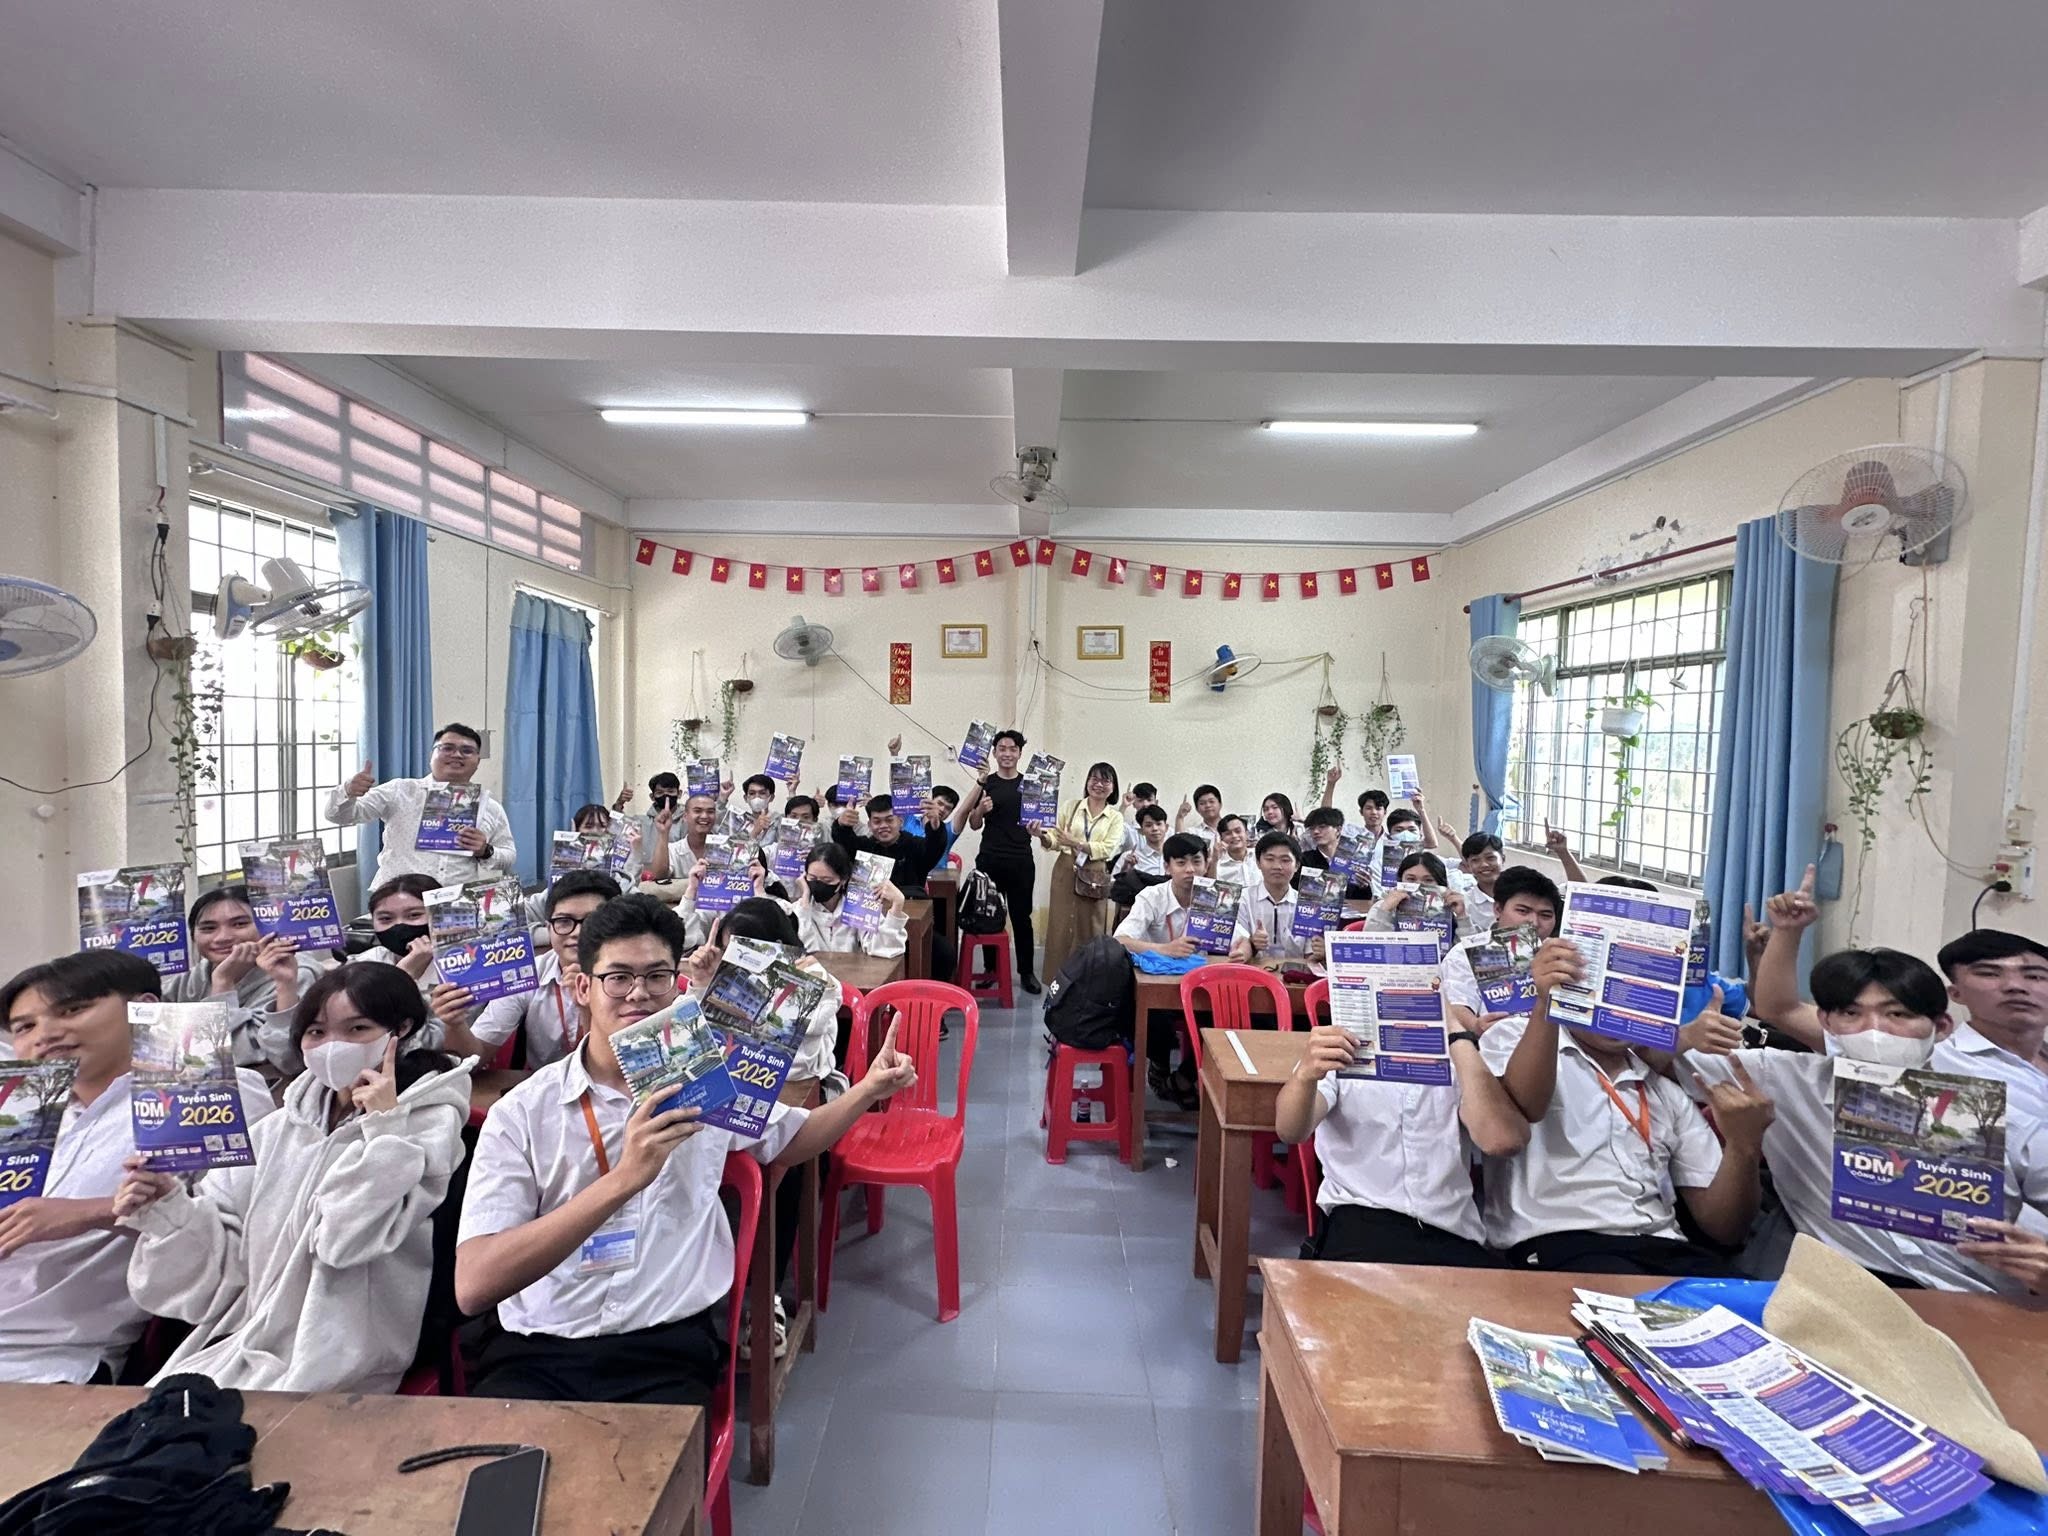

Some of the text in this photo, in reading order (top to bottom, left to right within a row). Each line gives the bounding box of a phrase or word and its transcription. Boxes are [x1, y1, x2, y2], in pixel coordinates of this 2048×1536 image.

[290, 905, 330, 921] 2026
[129, 930, 178, 949] 2026
[483, 945, 526, 967] 2026
[1520, 984, 1538, 998] 20
[767, 1055, 785, 1068] Sinh
[728, 1060, 779, 1089] 2026
[209, 1093, 231, 1102] Sinh
[179, 1105, 235, 1126] 2026
[6, 1154, 39, 1166] Sinh
[1916, 1159, 1992, 1182] Tuyển Sinh
[1913, 1174, 1990, 1205] 2026
